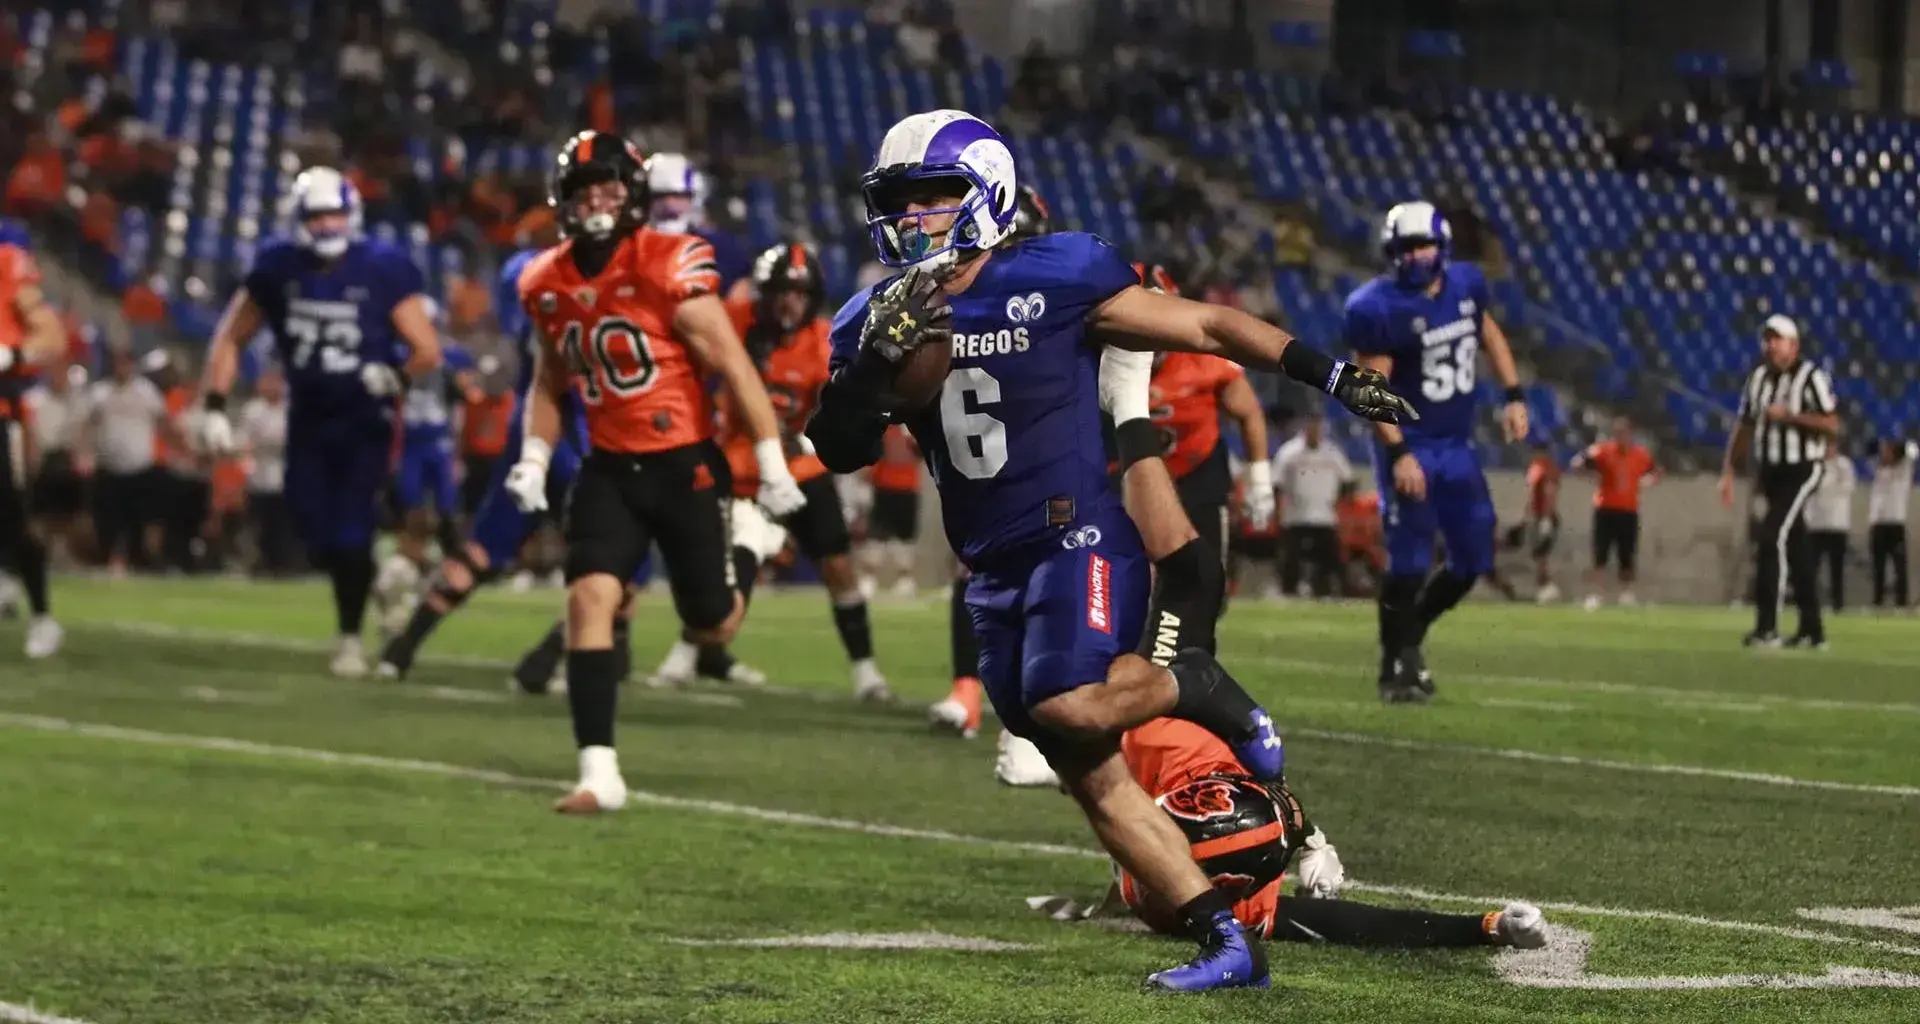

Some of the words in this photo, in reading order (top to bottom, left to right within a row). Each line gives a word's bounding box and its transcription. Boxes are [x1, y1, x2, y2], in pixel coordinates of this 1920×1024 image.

[557, 316, 660, 404] 40
[1421, 335, 1478, 402] 58
[940, 367, 1008, 480] 6
